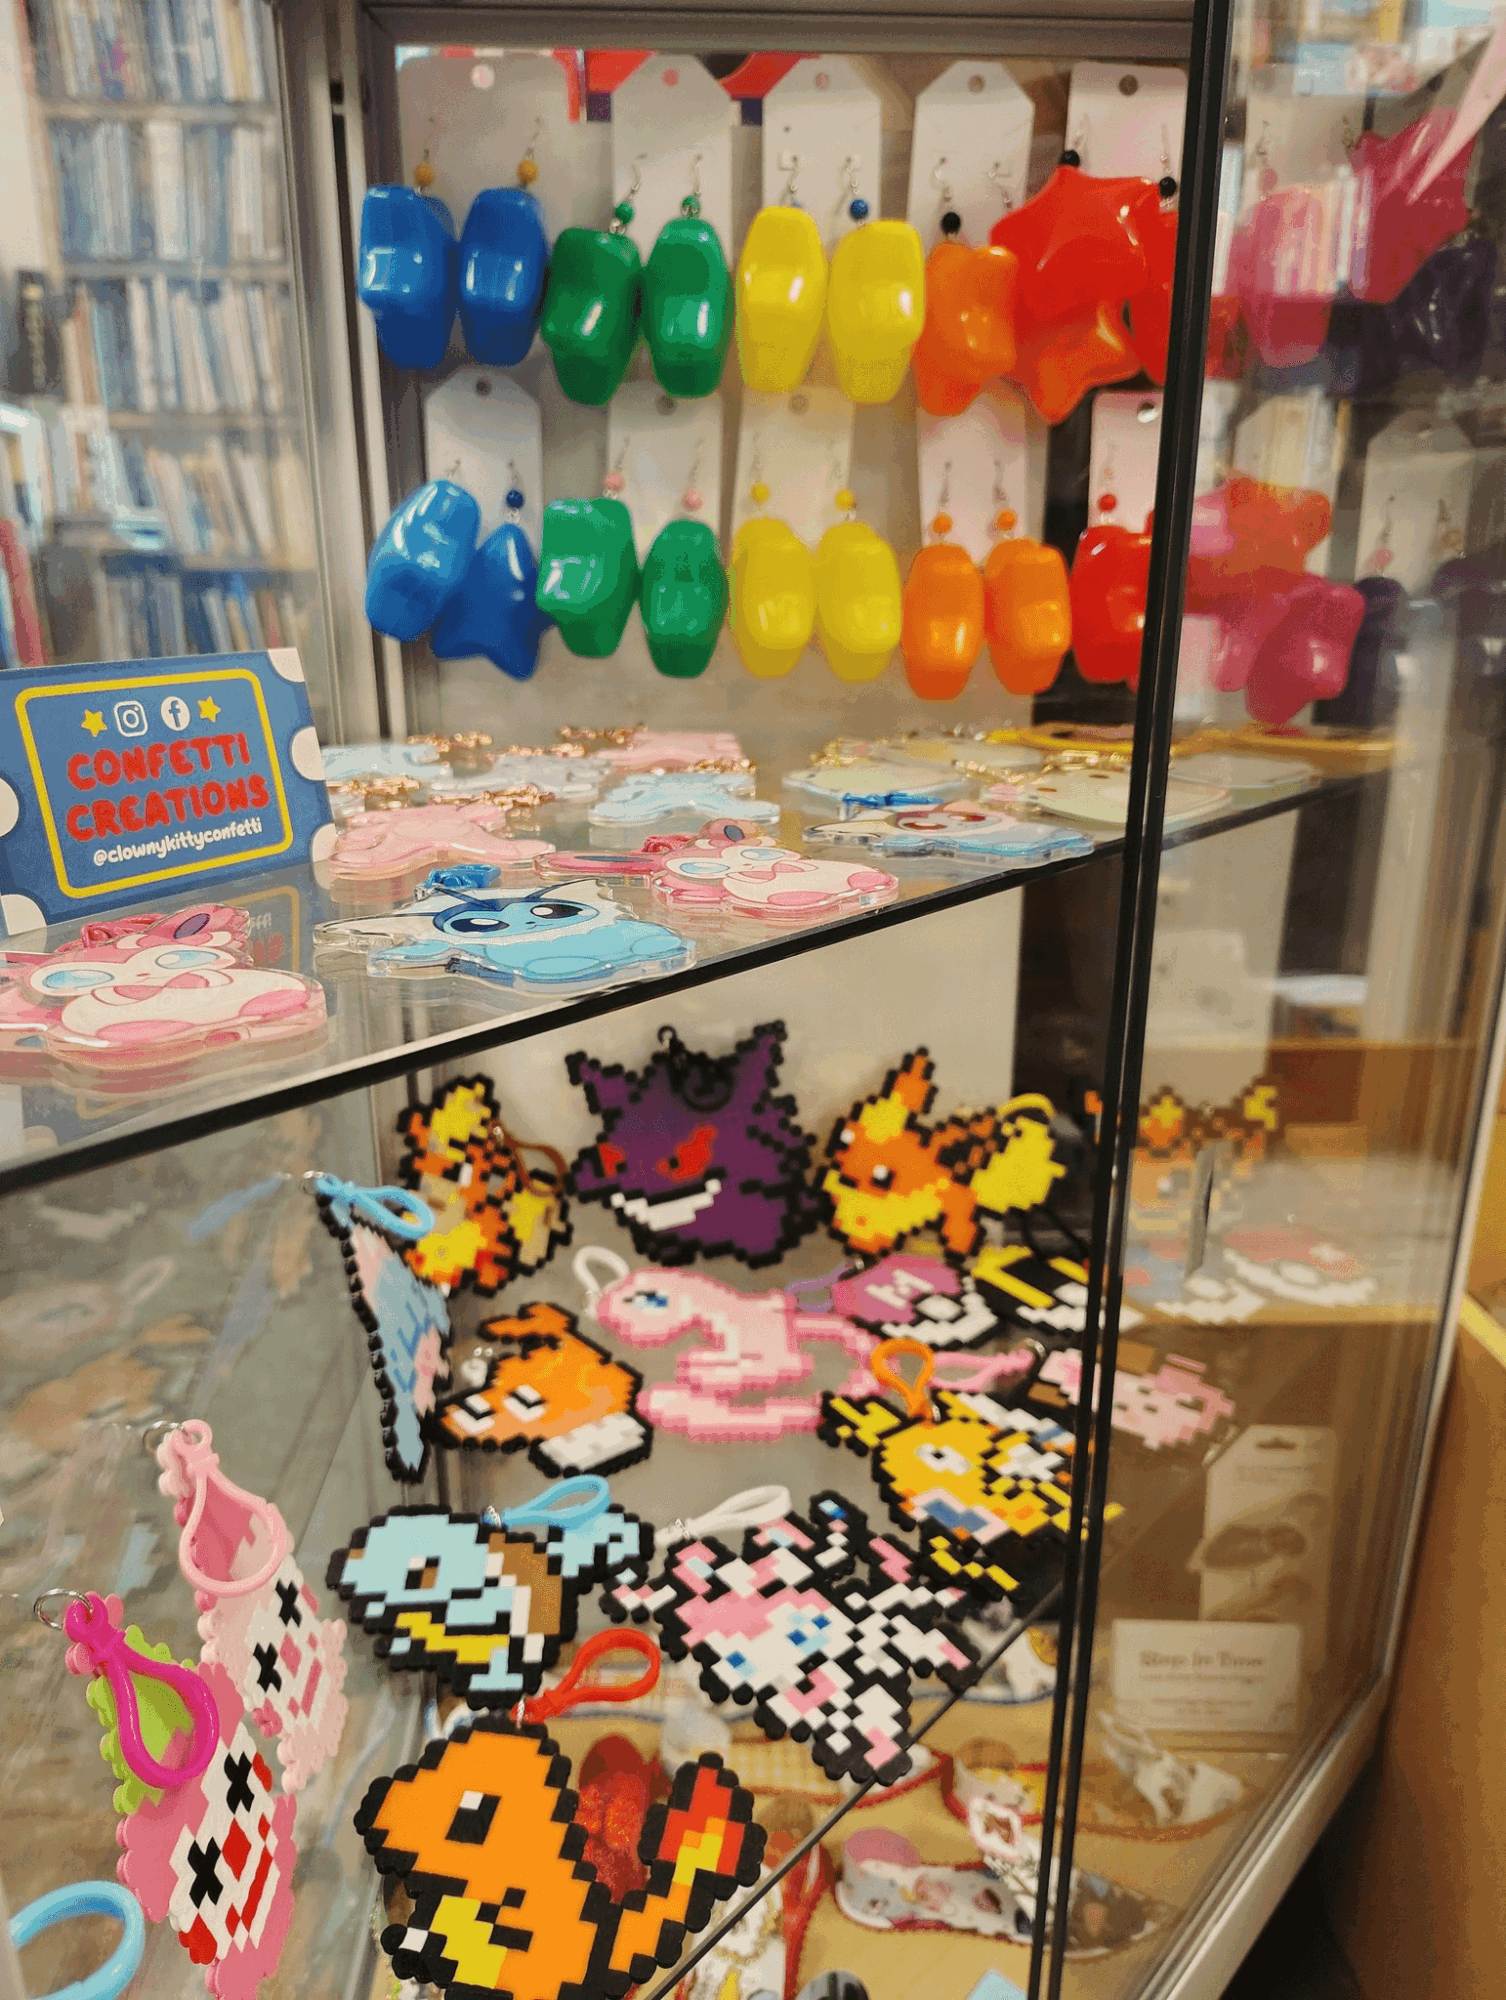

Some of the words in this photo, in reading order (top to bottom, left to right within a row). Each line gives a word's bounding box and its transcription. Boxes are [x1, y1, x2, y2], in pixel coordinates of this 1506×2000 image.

[67, 731, 250, 791] CONFETTI
[66, 773, 270, 842] CREATIONS
[93, 817, 263, 867] @clownykittyconfetti
